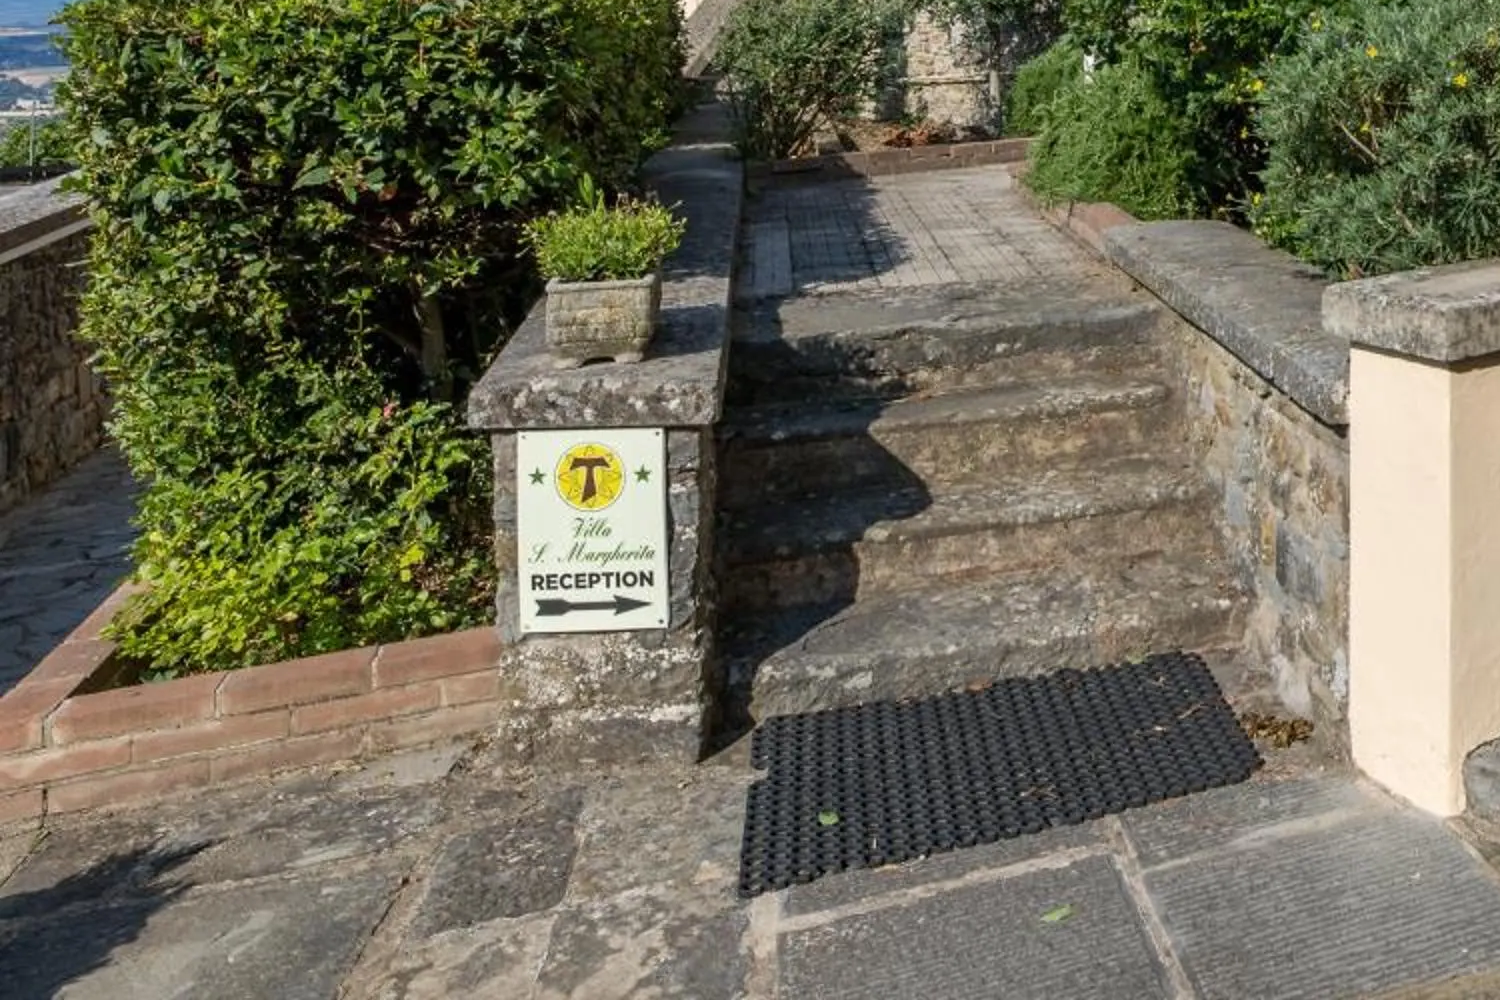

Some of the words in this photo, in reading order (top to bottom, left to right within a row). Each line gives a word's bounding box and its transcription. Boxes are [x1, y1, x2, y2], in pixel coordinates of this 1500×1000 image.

[573, 517, 612, 538] Villa
[557, 541, 656, 567] Margherita
[531, 570, 655, 591] RECEPTION
